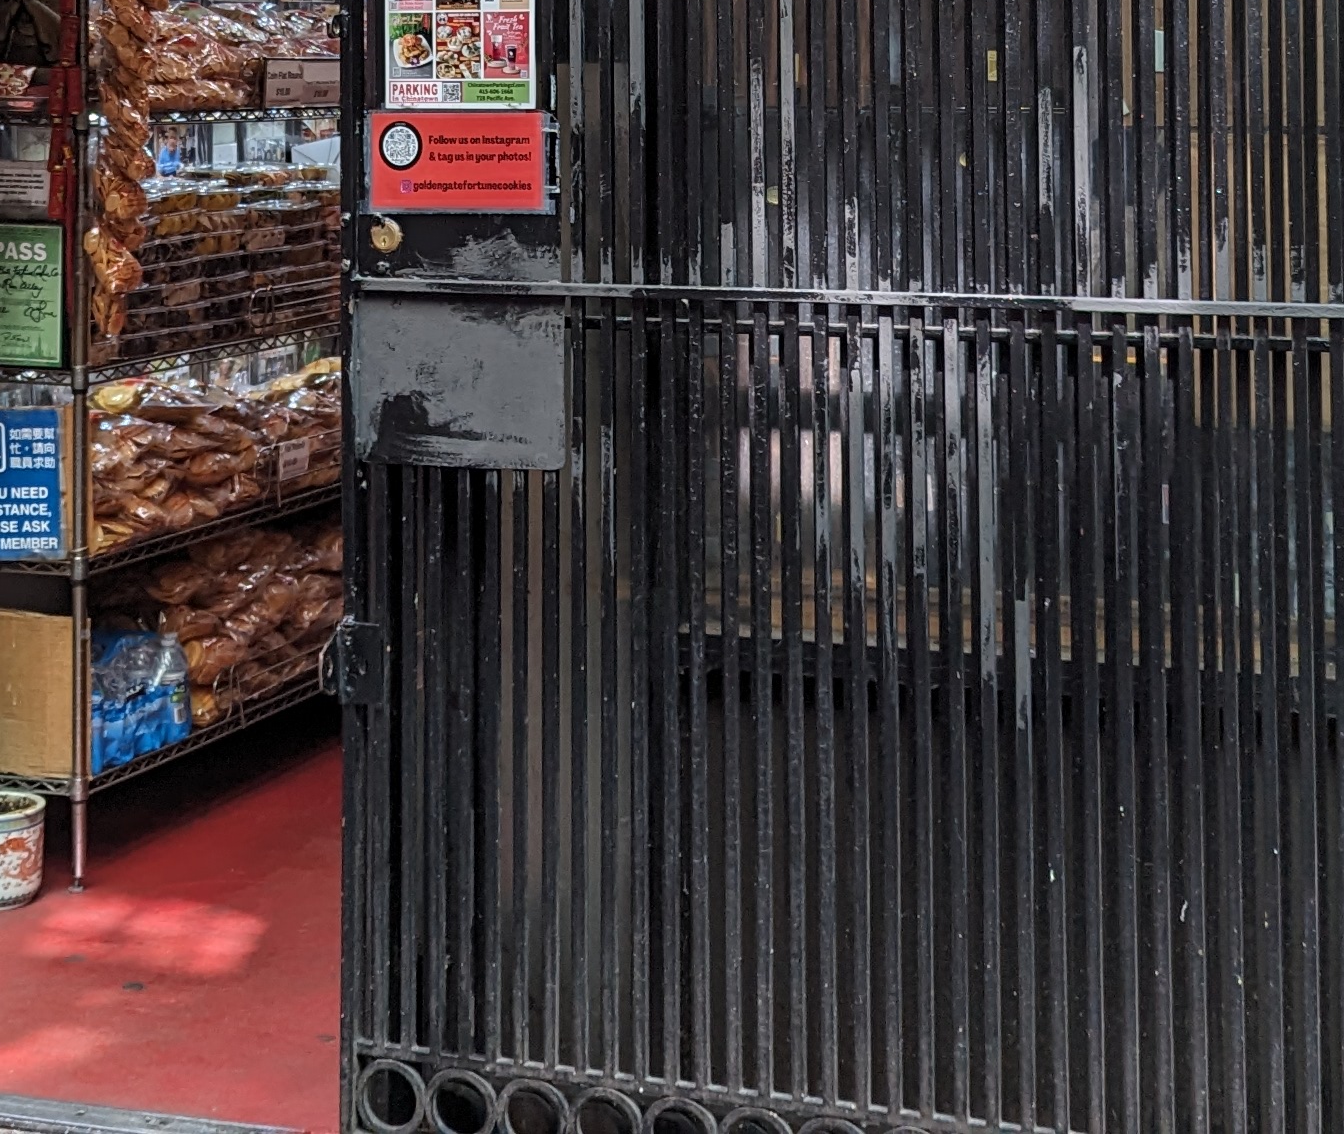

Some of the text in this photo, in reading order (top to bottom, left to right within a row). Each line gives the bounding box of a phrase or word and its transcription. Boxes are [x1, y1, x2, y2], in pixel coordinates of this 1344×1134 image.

[392, 83, 439, 96] PARKING
[428, 134, 531, 147] Follow us on Instagram
[437, 152, 454, 164] tag
[454, 153, 465, 162] us
[465, 151, 474, 161] in
[475, 153, 496, 164] your
[497, 151, 532, 164] photos!
[412, 179, 532, 193] goldengatefortunecookies
[10, 486, 49, 499] NEED
[21, 520, 51, 533] ASK
[0, 536, 58, 550] MEMBER
